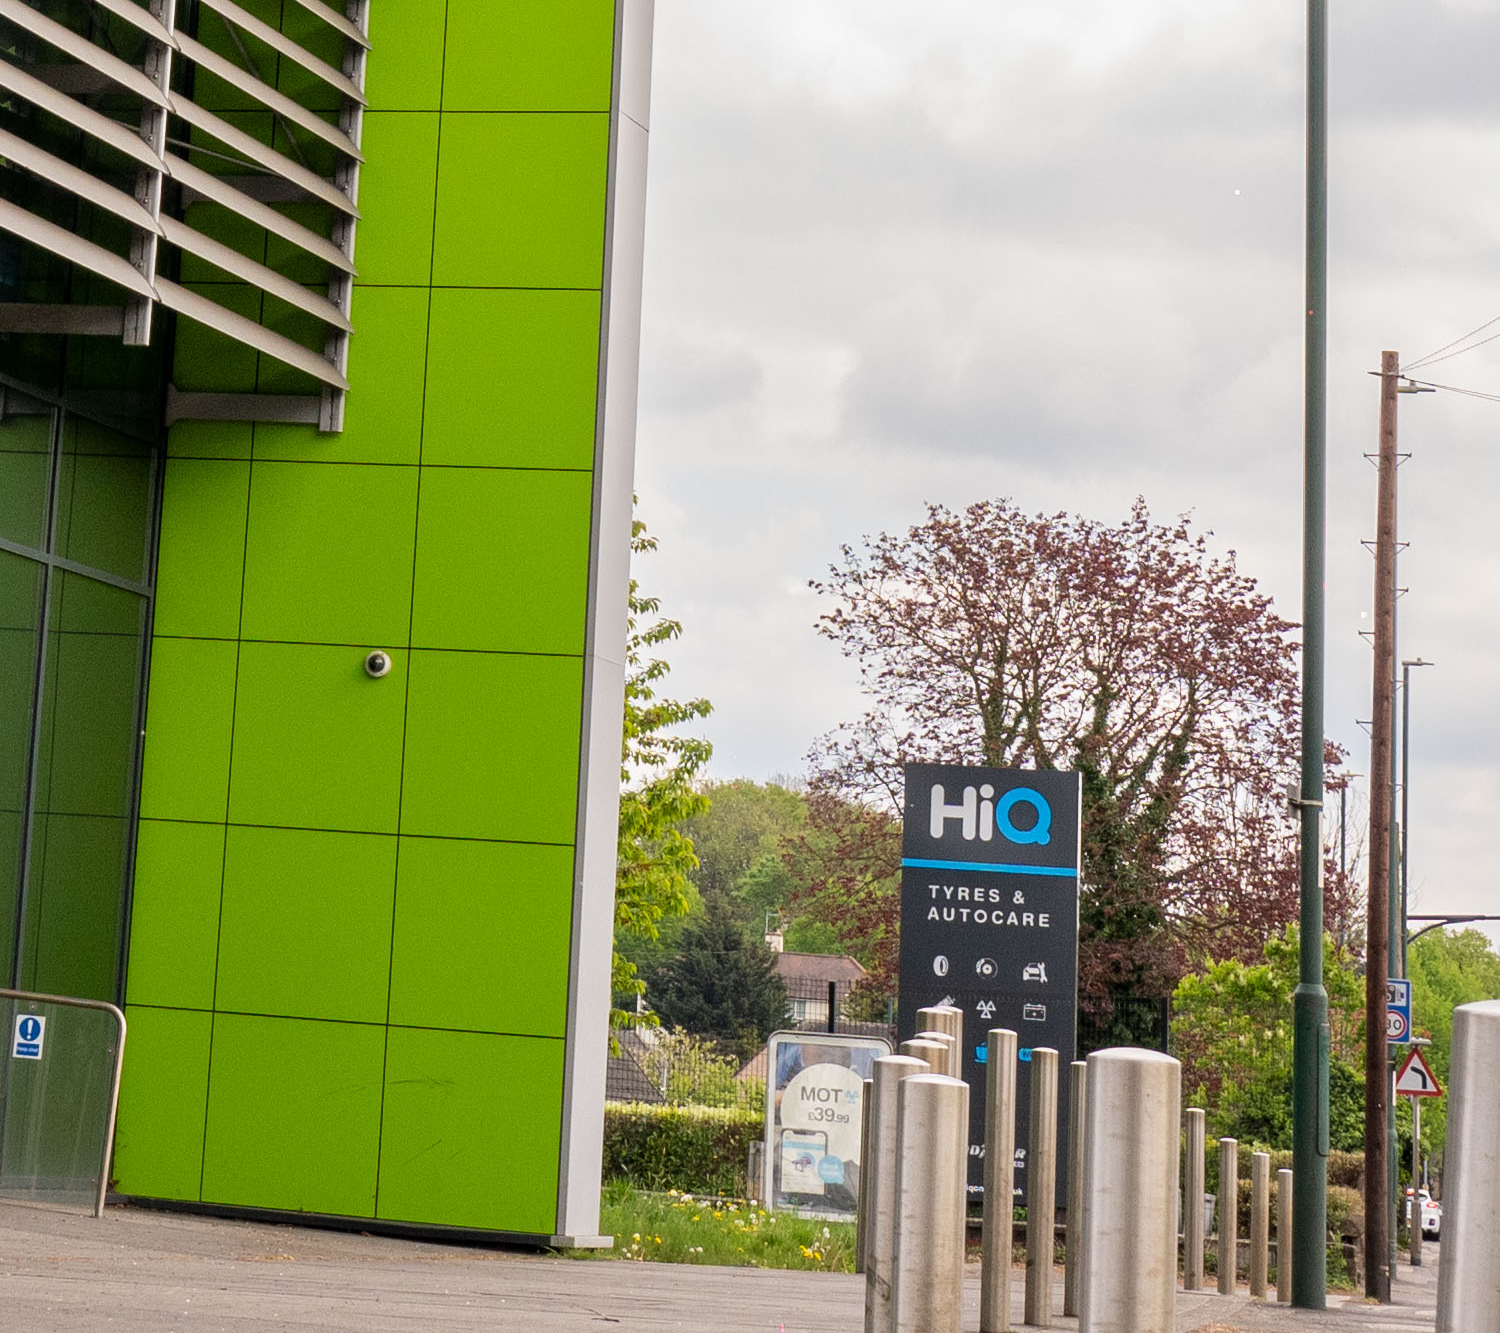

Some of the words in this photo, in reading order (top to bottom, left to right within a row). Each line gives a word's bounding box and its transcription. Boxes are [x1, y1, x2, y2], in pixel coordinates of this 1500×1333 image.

[930, 784, 1052, 845] HiQ
[928, 884, 1001, 903] TYRES
[1012, 890, 1025, 905] &
[927, 906, 1051, 928] AUTOCARE
[800, 1085, 843, 1104] MOT
[807, 1106, 850, 1124] £39.99
